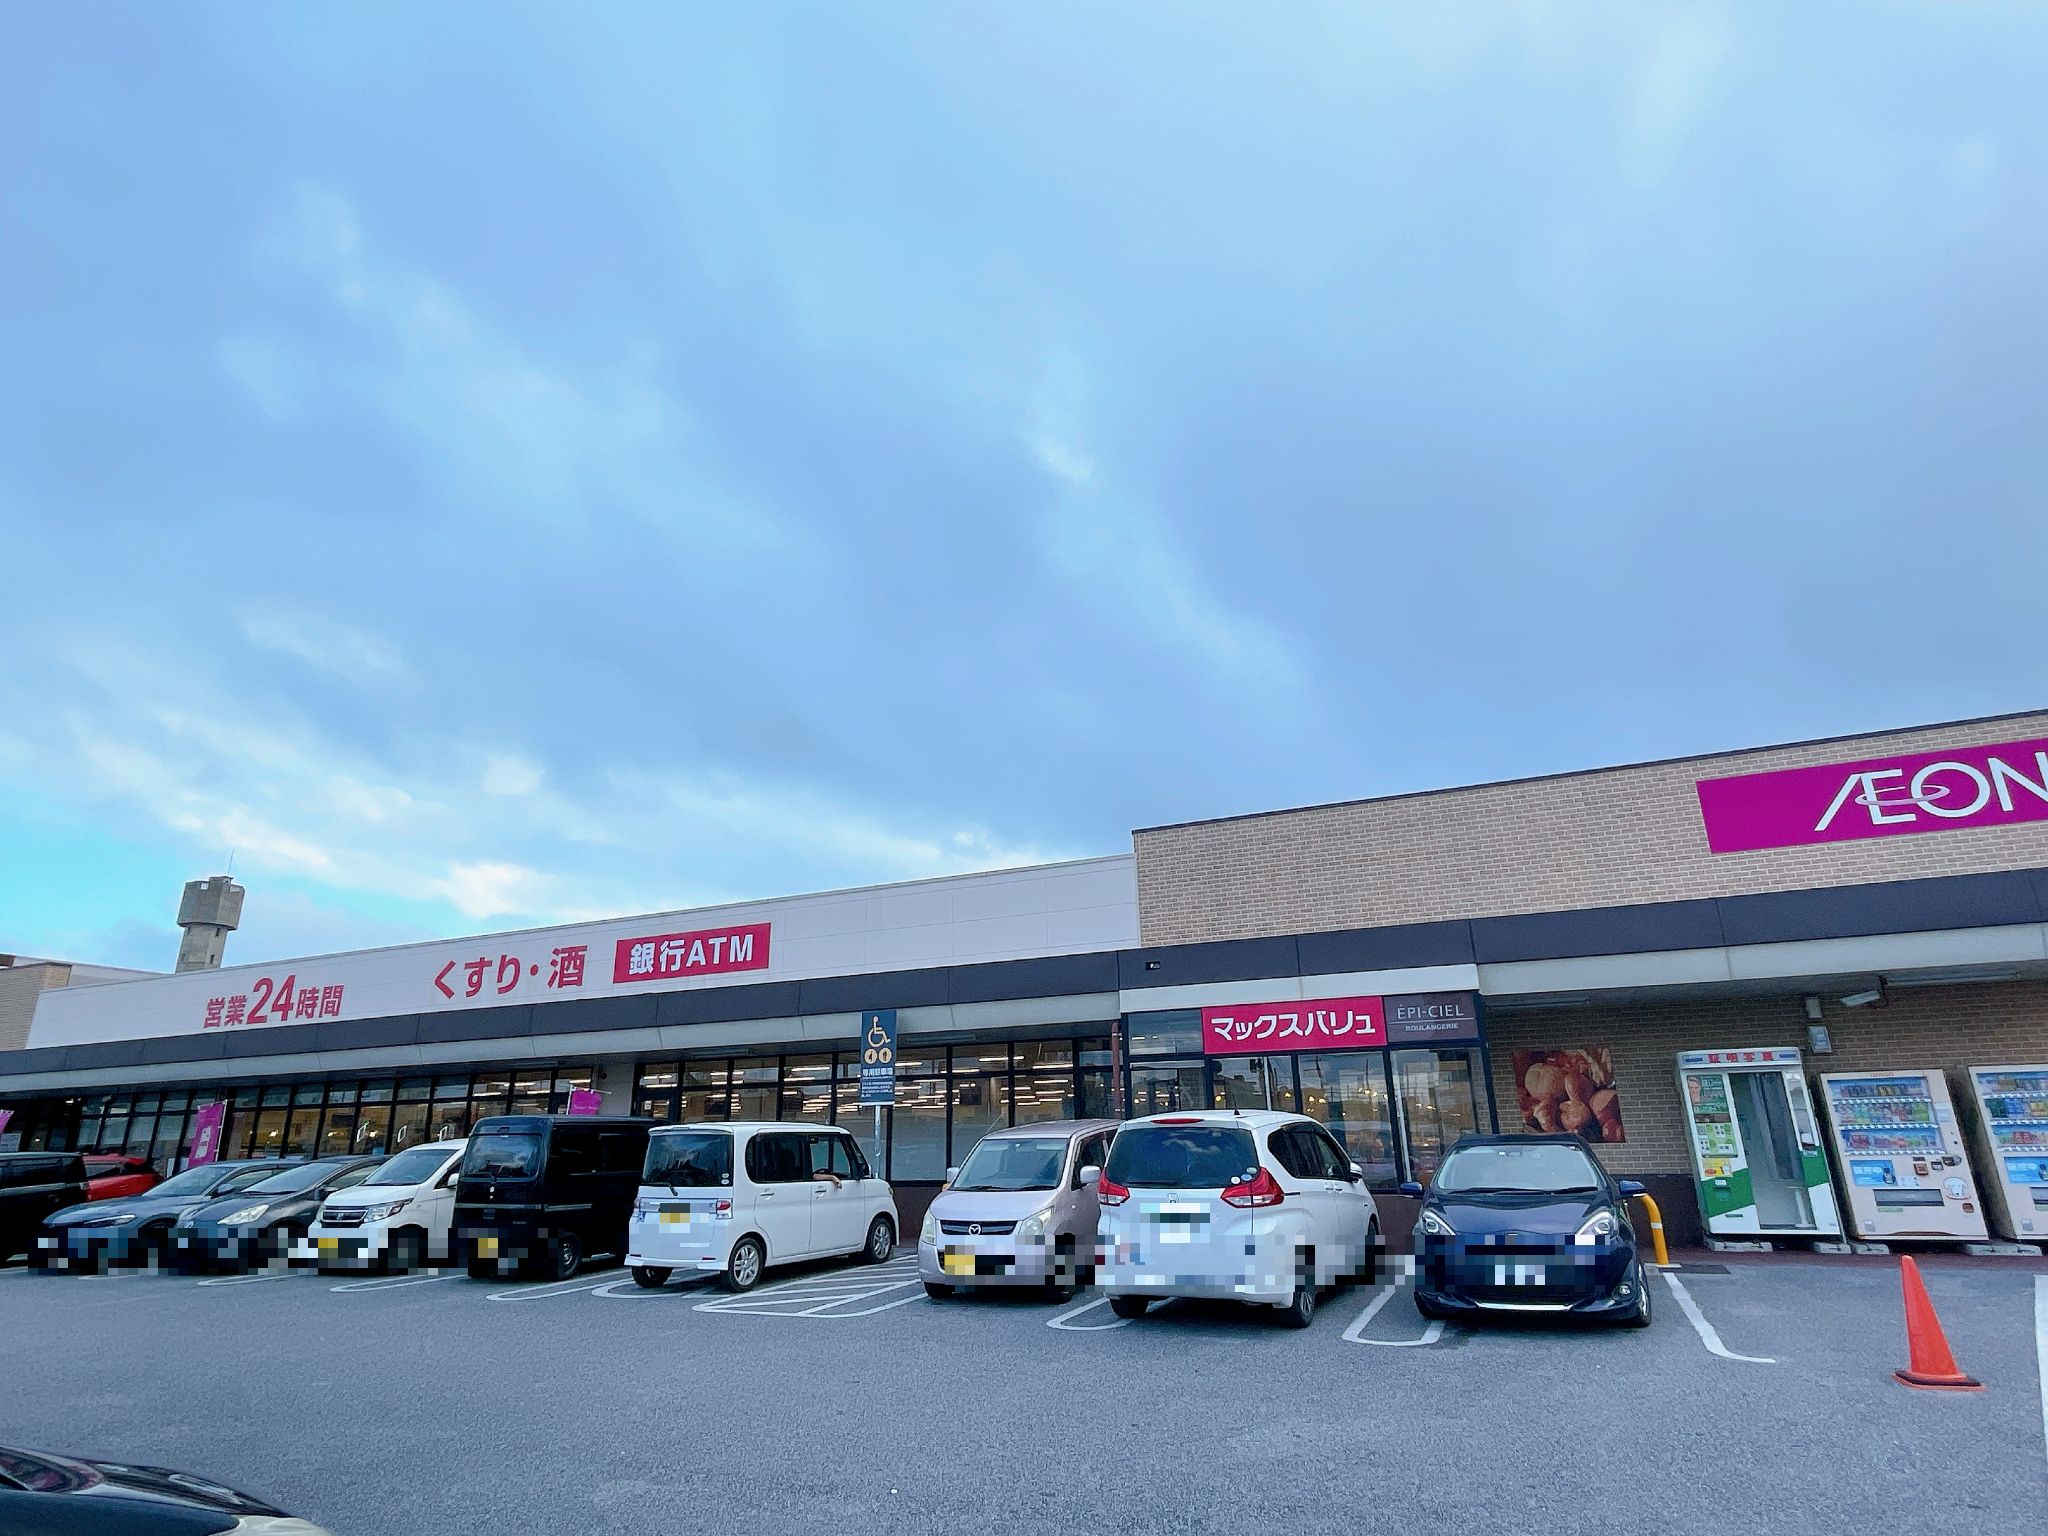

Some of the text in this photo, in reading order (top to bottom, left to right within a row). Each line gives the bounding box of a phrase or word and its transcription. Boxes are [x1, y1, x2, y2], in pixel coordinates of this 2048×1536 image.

[434, 945, 588, 1000] くすり・酒
[629, 934, 753, 975] 銀行ATM
[203, 974, 345, 1029] 営業24時間
[1211, 1010, 1376, 1041] マックスバリュ
[1405, 1022, 1459, 1032] BOULANGERIE
